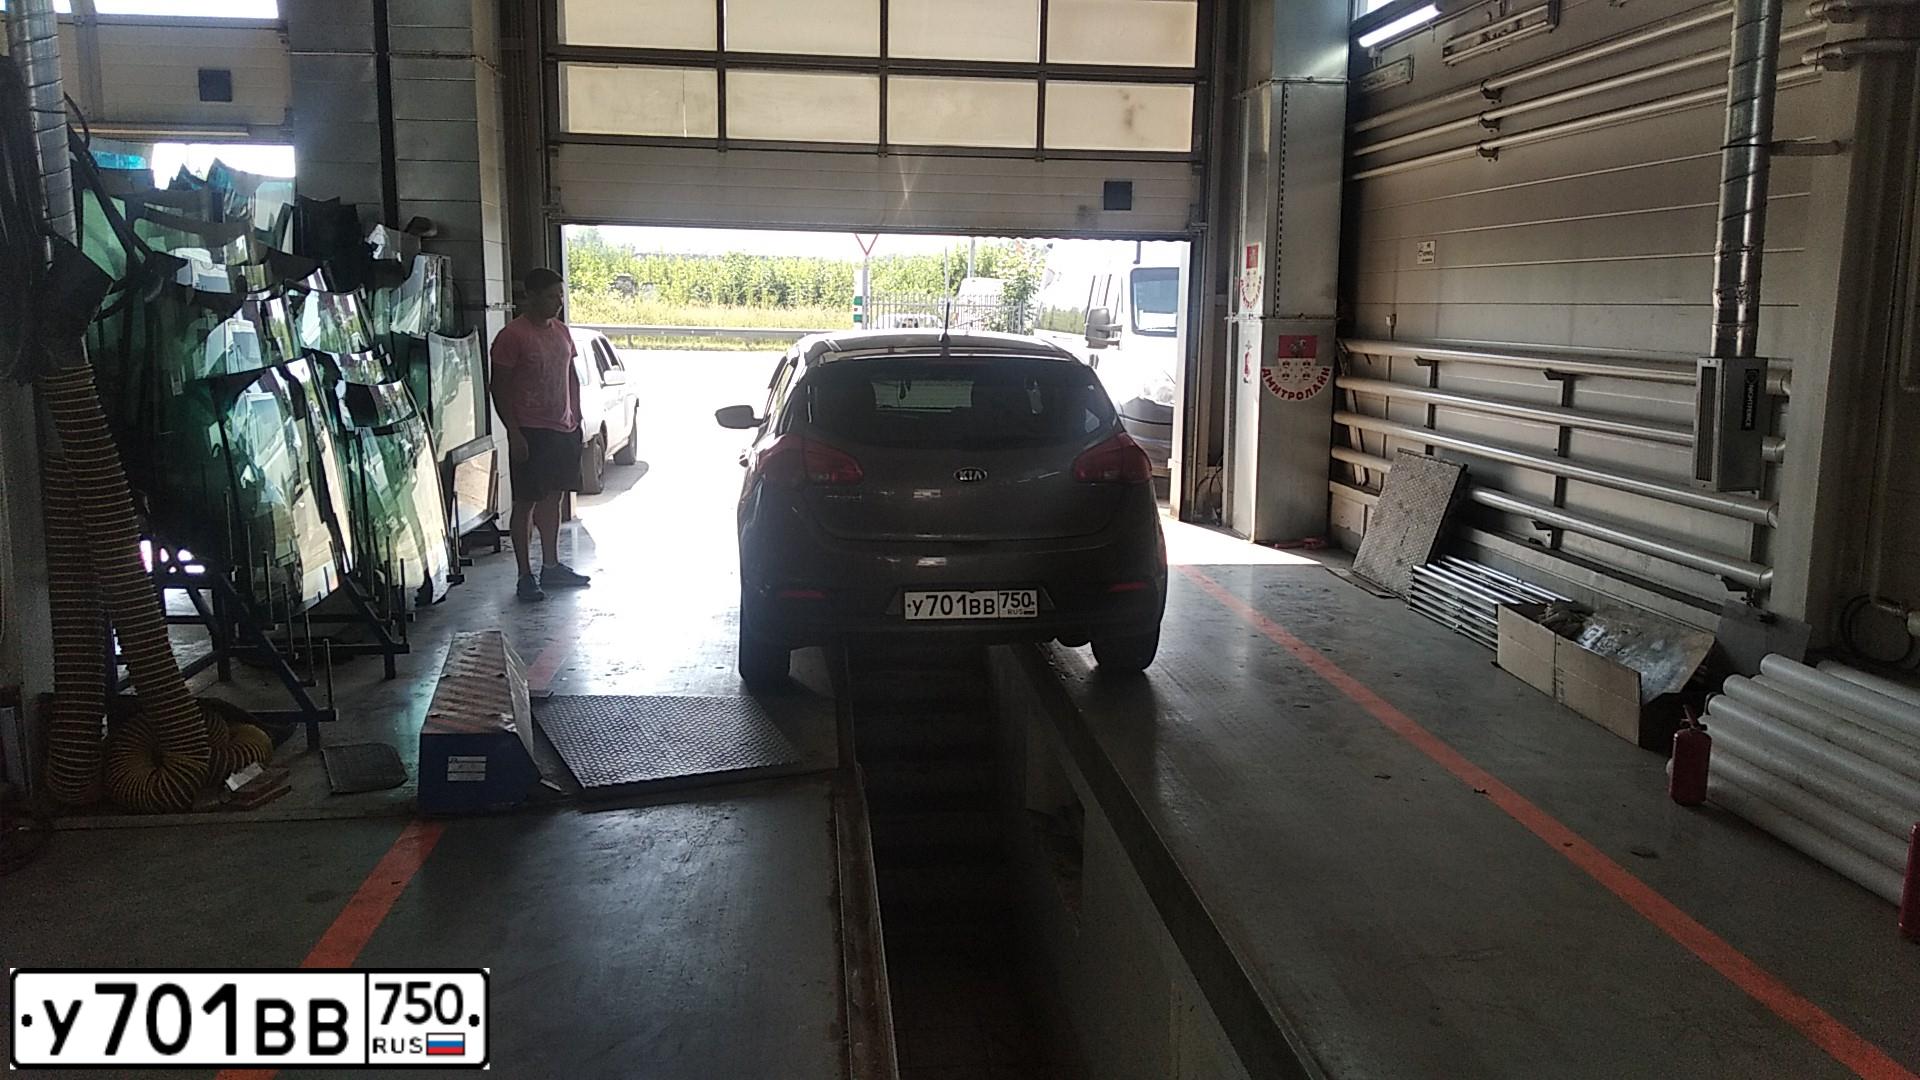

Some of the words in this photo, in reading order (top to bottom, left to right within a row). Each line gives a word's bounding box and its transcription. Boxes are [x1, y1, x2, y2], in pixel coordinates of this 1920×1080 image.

[1261, 367, 1331, 400] ДМИТРОЛАЙН
[959, 470, 982, 481] KIA
[912, 594, 996, 617] У701ВВ
[1000, 592, 1032, 609] 750
